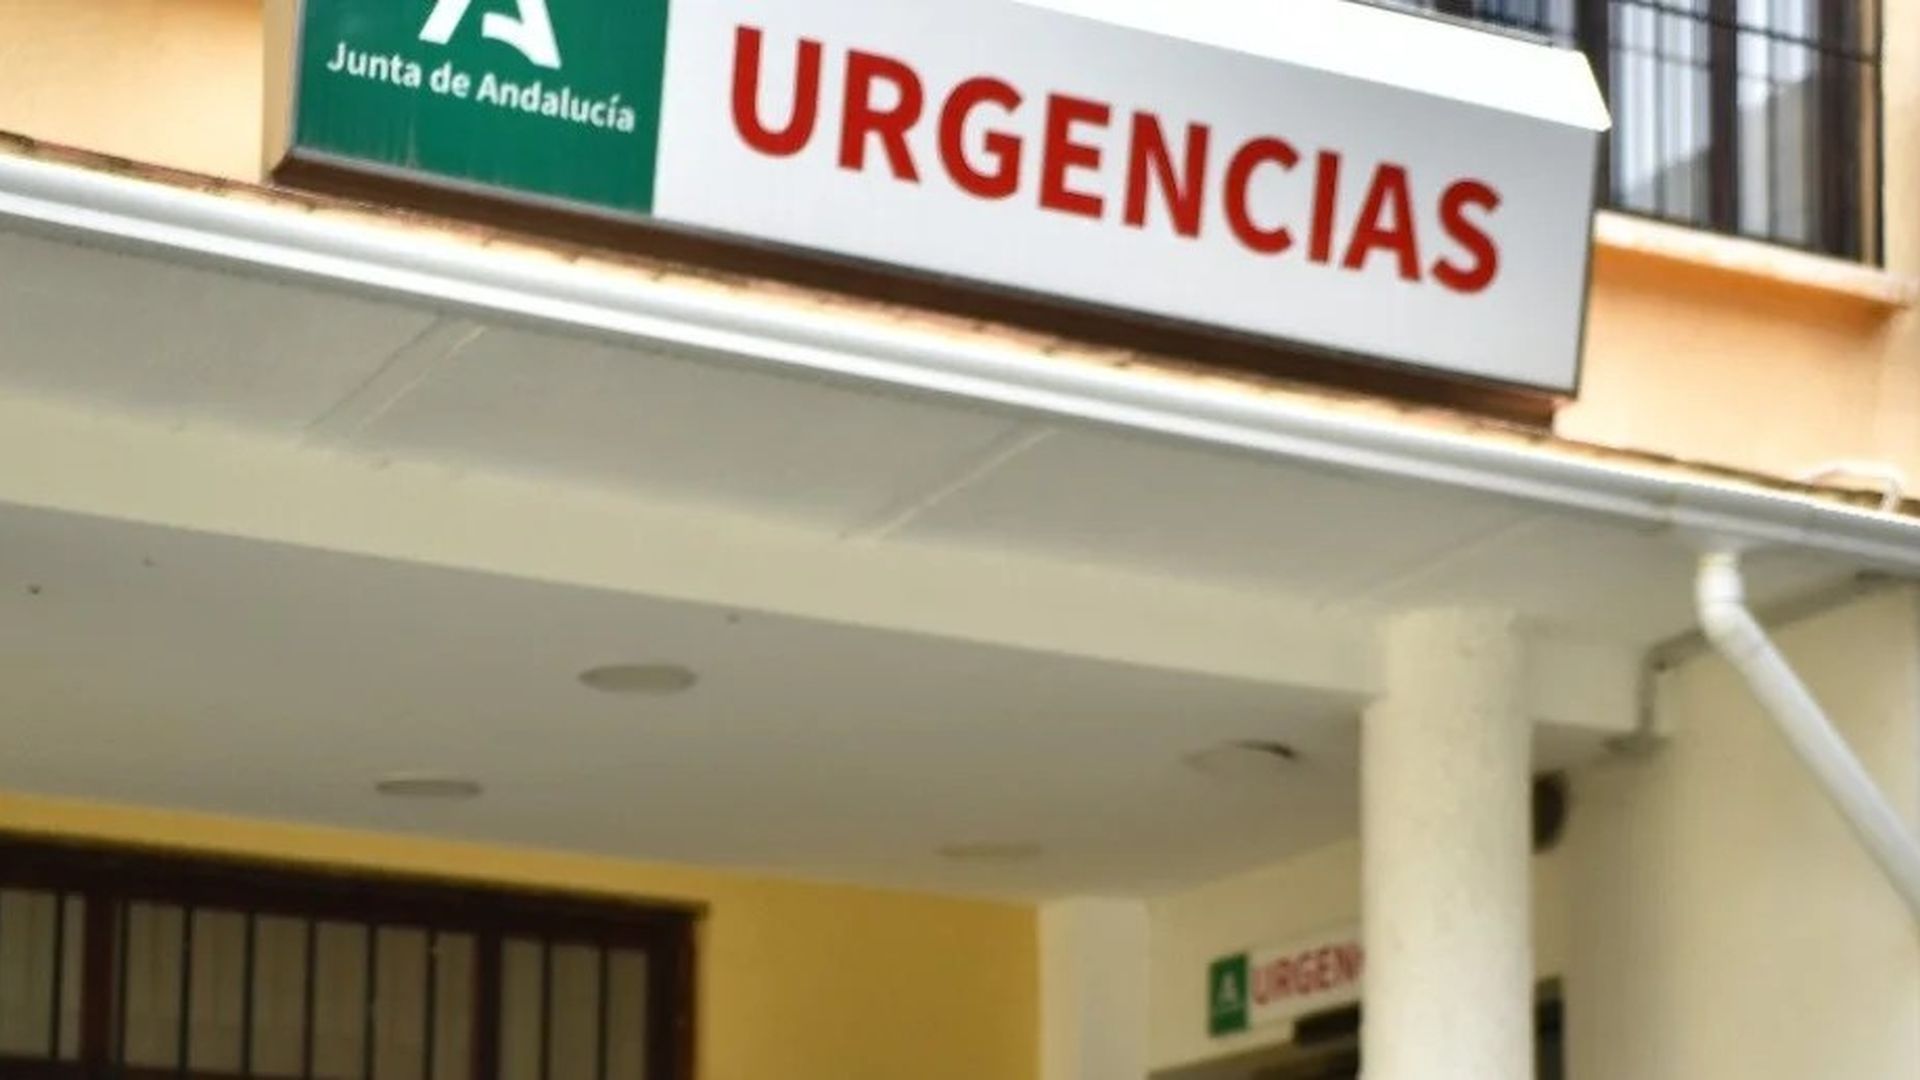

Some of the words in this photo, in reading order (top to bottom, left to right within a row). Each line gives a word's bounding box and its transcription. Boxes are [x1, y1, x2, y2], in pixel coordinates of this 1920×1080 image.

[327, 41, 422, 88] Junta
[430, 61, 471, 98] de
[476, 72, 636, 132] Andalucía
[730, 25, 1502, 295] URGENCIAS
[1253, 943, 1364, 1006] URGEN
